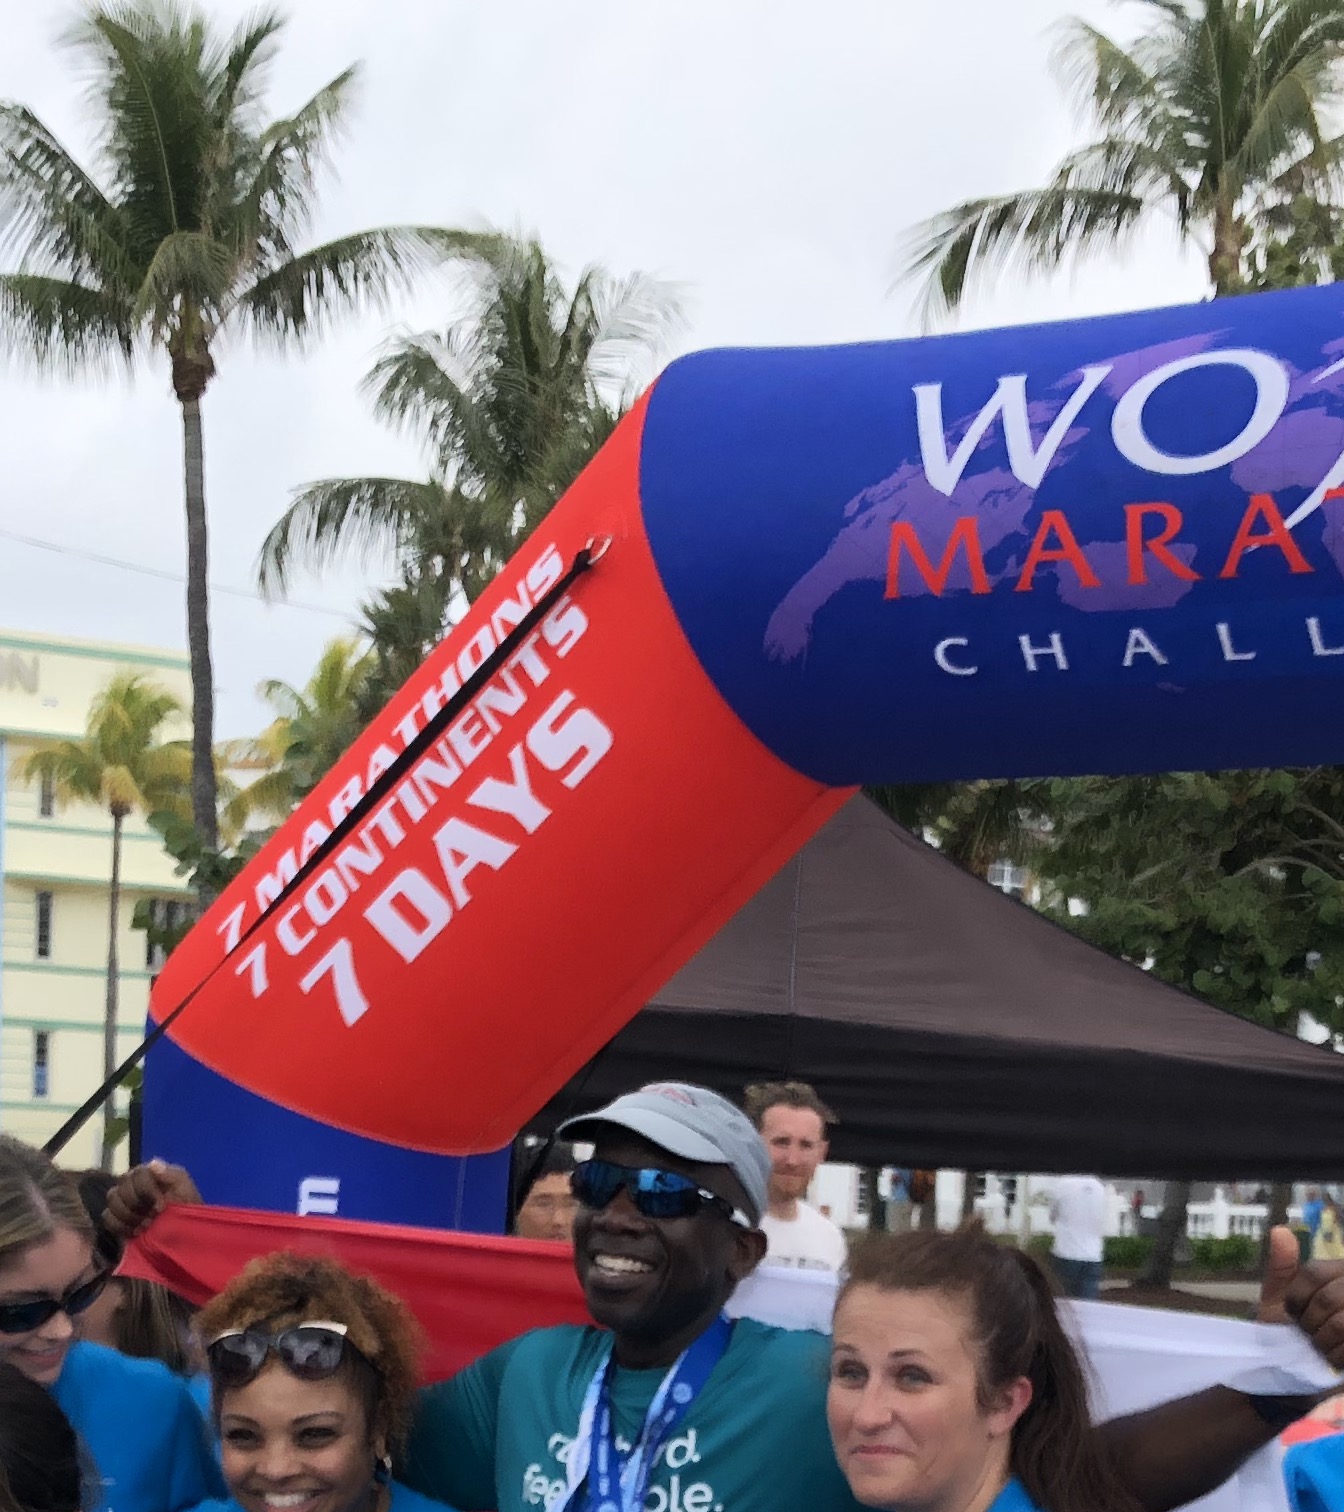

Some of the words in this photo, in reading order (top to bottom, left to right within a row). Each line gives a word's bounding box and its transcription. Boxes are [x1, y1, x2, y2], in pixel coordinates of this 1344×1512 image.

[234, 943, 271, 998] 7
[275, 595, 591, 957] CONTINENTS
[253, 543, 564, 912] MARATHONS
[298, 937, 370, 1028] 7
[362, 690, 614, 965] DAYS
